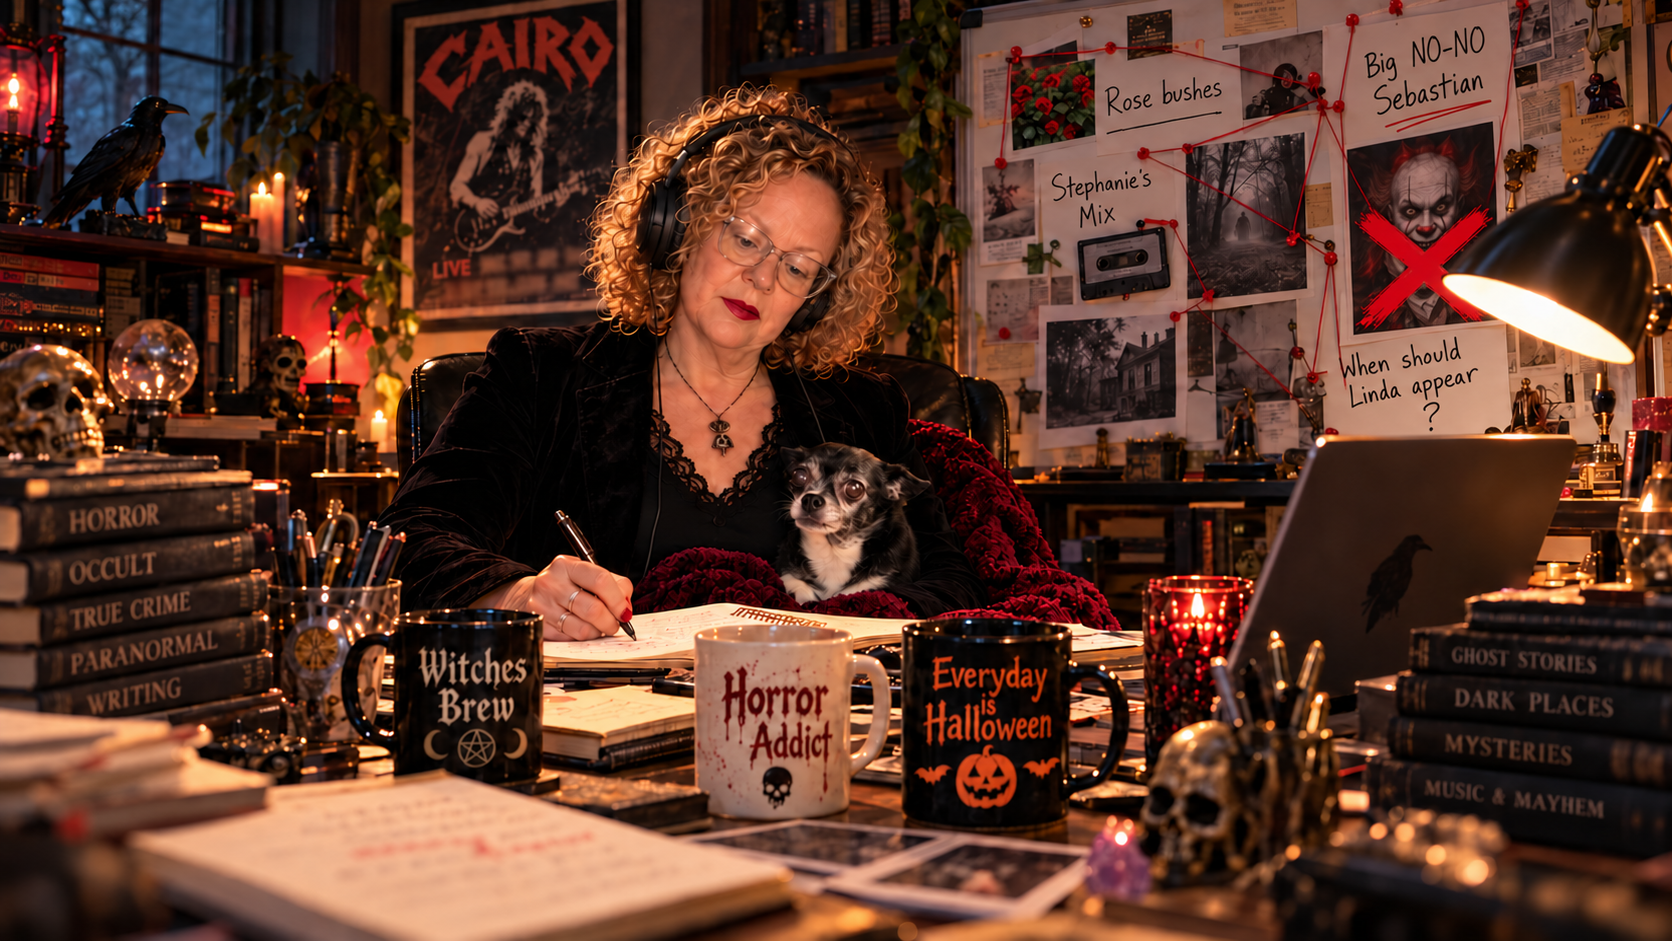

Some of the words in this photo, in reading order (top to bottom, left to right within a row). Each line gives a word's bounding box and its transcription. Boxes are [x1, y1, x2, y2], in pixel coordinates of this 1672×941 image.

[417, 16, 614, 113] CAIRO
[1364, 52, 1397, 81] Big
[1411, 26, 1485, 67] NO-NO
[1104, 86, 1153, 116] Rose
[1162, 77, 1222, 105] bushes
[1373, 73, 1484, 116] Sebastian
[1051, 169, 1152, 202] Stephanie's
[1079, 203, 1116, 228] Mix
[432, 259, 471, 279] LIVE
[1339, 351, 1390, 379] When
[1401, 336, 1462, 369] should
[1348, 378, 1402, 408] Linda
[1411, 367, 1479, 400] appear
[1422, 401, 1441, 432] ?
[69, 503, 160, 534] HORROR
[69, 552, 157, 585] OCCULT
[69, 602, 124, 630] TRUE
[130, 591, 191, 620] CRIME
[70, 630, 218, 675] PARANORMAL
[418, 647, 528, 690] Witches
[1451, 646, 1510, 667] GHOST
[1518, 651, 1597, 675] STORIES
[87, 677, 182, 715] WRITING
[932, 655, 1048, 703] Everyday
[437, 687, 515, 726] Brew
[721, 666, 829, 734] Horror
[981, 693, 996, 716] is
[1454, 688, 1516, 712] DARK
[1529, 692, 1614, 718] PLACES
[923, 702, 1053, 746] Halloween
[749, 720, 832, 774] Addict
[1445, 734, 1573, 766] MYSTERIES
[1424, 780, 1485, 803] MUSIC
[1492, 788, 1505, 806] &
[1514, 791, 1605, 819] MAYHEM
